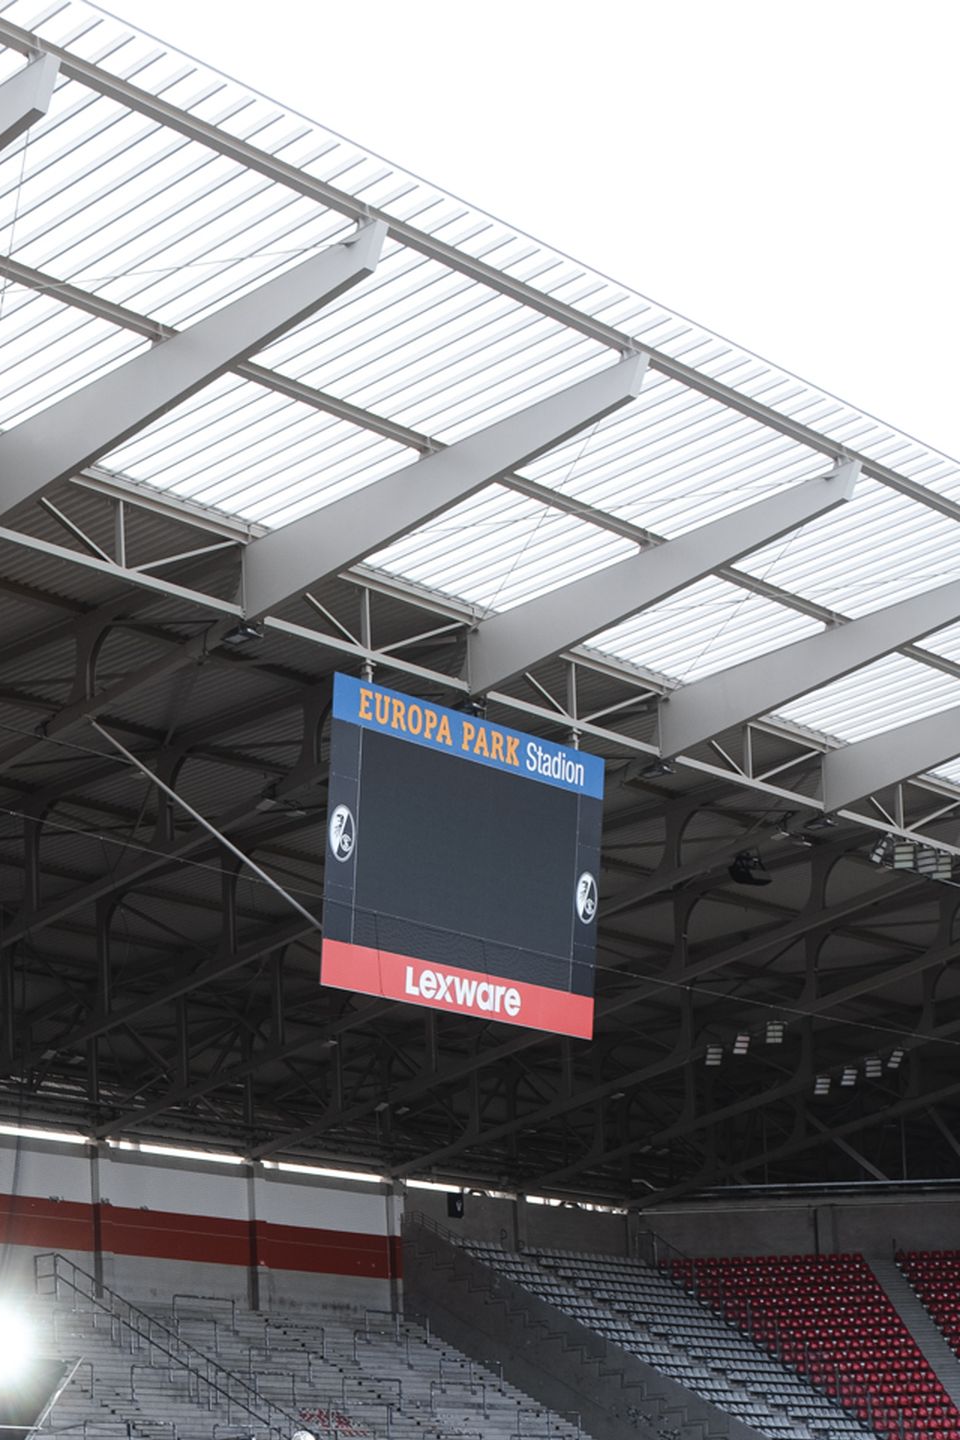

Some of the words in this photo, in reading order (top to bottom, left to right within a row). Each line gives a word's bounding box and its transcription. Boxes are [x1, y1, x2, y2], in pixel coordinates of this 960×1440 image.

[358, 687, 453, 746] EUROPA
[461, 721, 520, 767] PARK
[526, 742, 585, 786] Stadion
[405, 965, 522, 1017] Lexware
